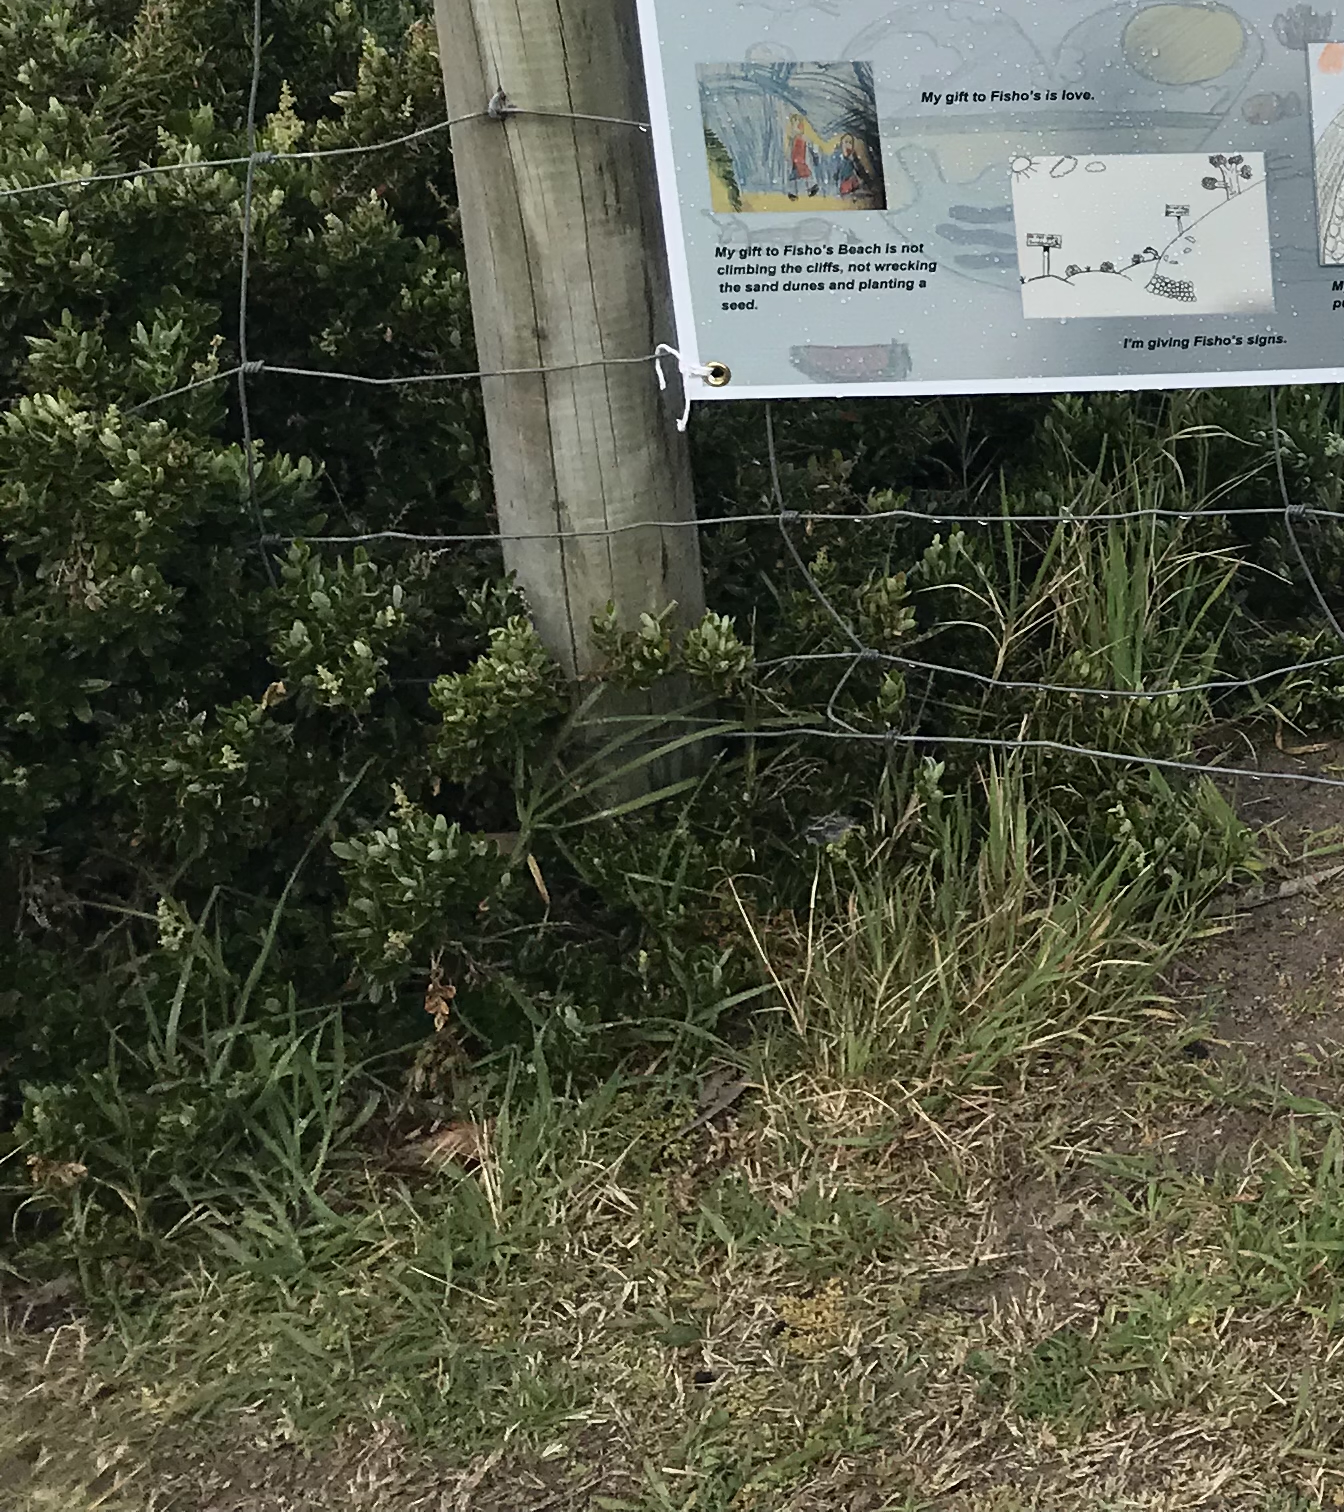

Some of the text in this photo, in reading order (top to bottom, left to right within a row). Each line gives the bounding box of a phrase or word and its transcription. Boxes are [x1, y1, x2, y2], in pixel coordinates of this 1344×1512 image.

[920, 89, 1094, 105] My gift to Fisho's is love.
[714, 246, 735, 260] My
[738, 246, 762, 260] gift
[765, 246, 779, 256] to
[837, 243, 881, 254] Beach
[885, 243, 896, 253] is
[901, 243, 923, 253] not
[716, 260, 937, 276] climbing the cliffs, not wrecking
[718, 278, 926, 293] the sand dunes and planting a
[721, 299, 757, 310] seed.
[1147, 337, 1189, 350] giving
[1246, 334, 1287, 347] signs.
